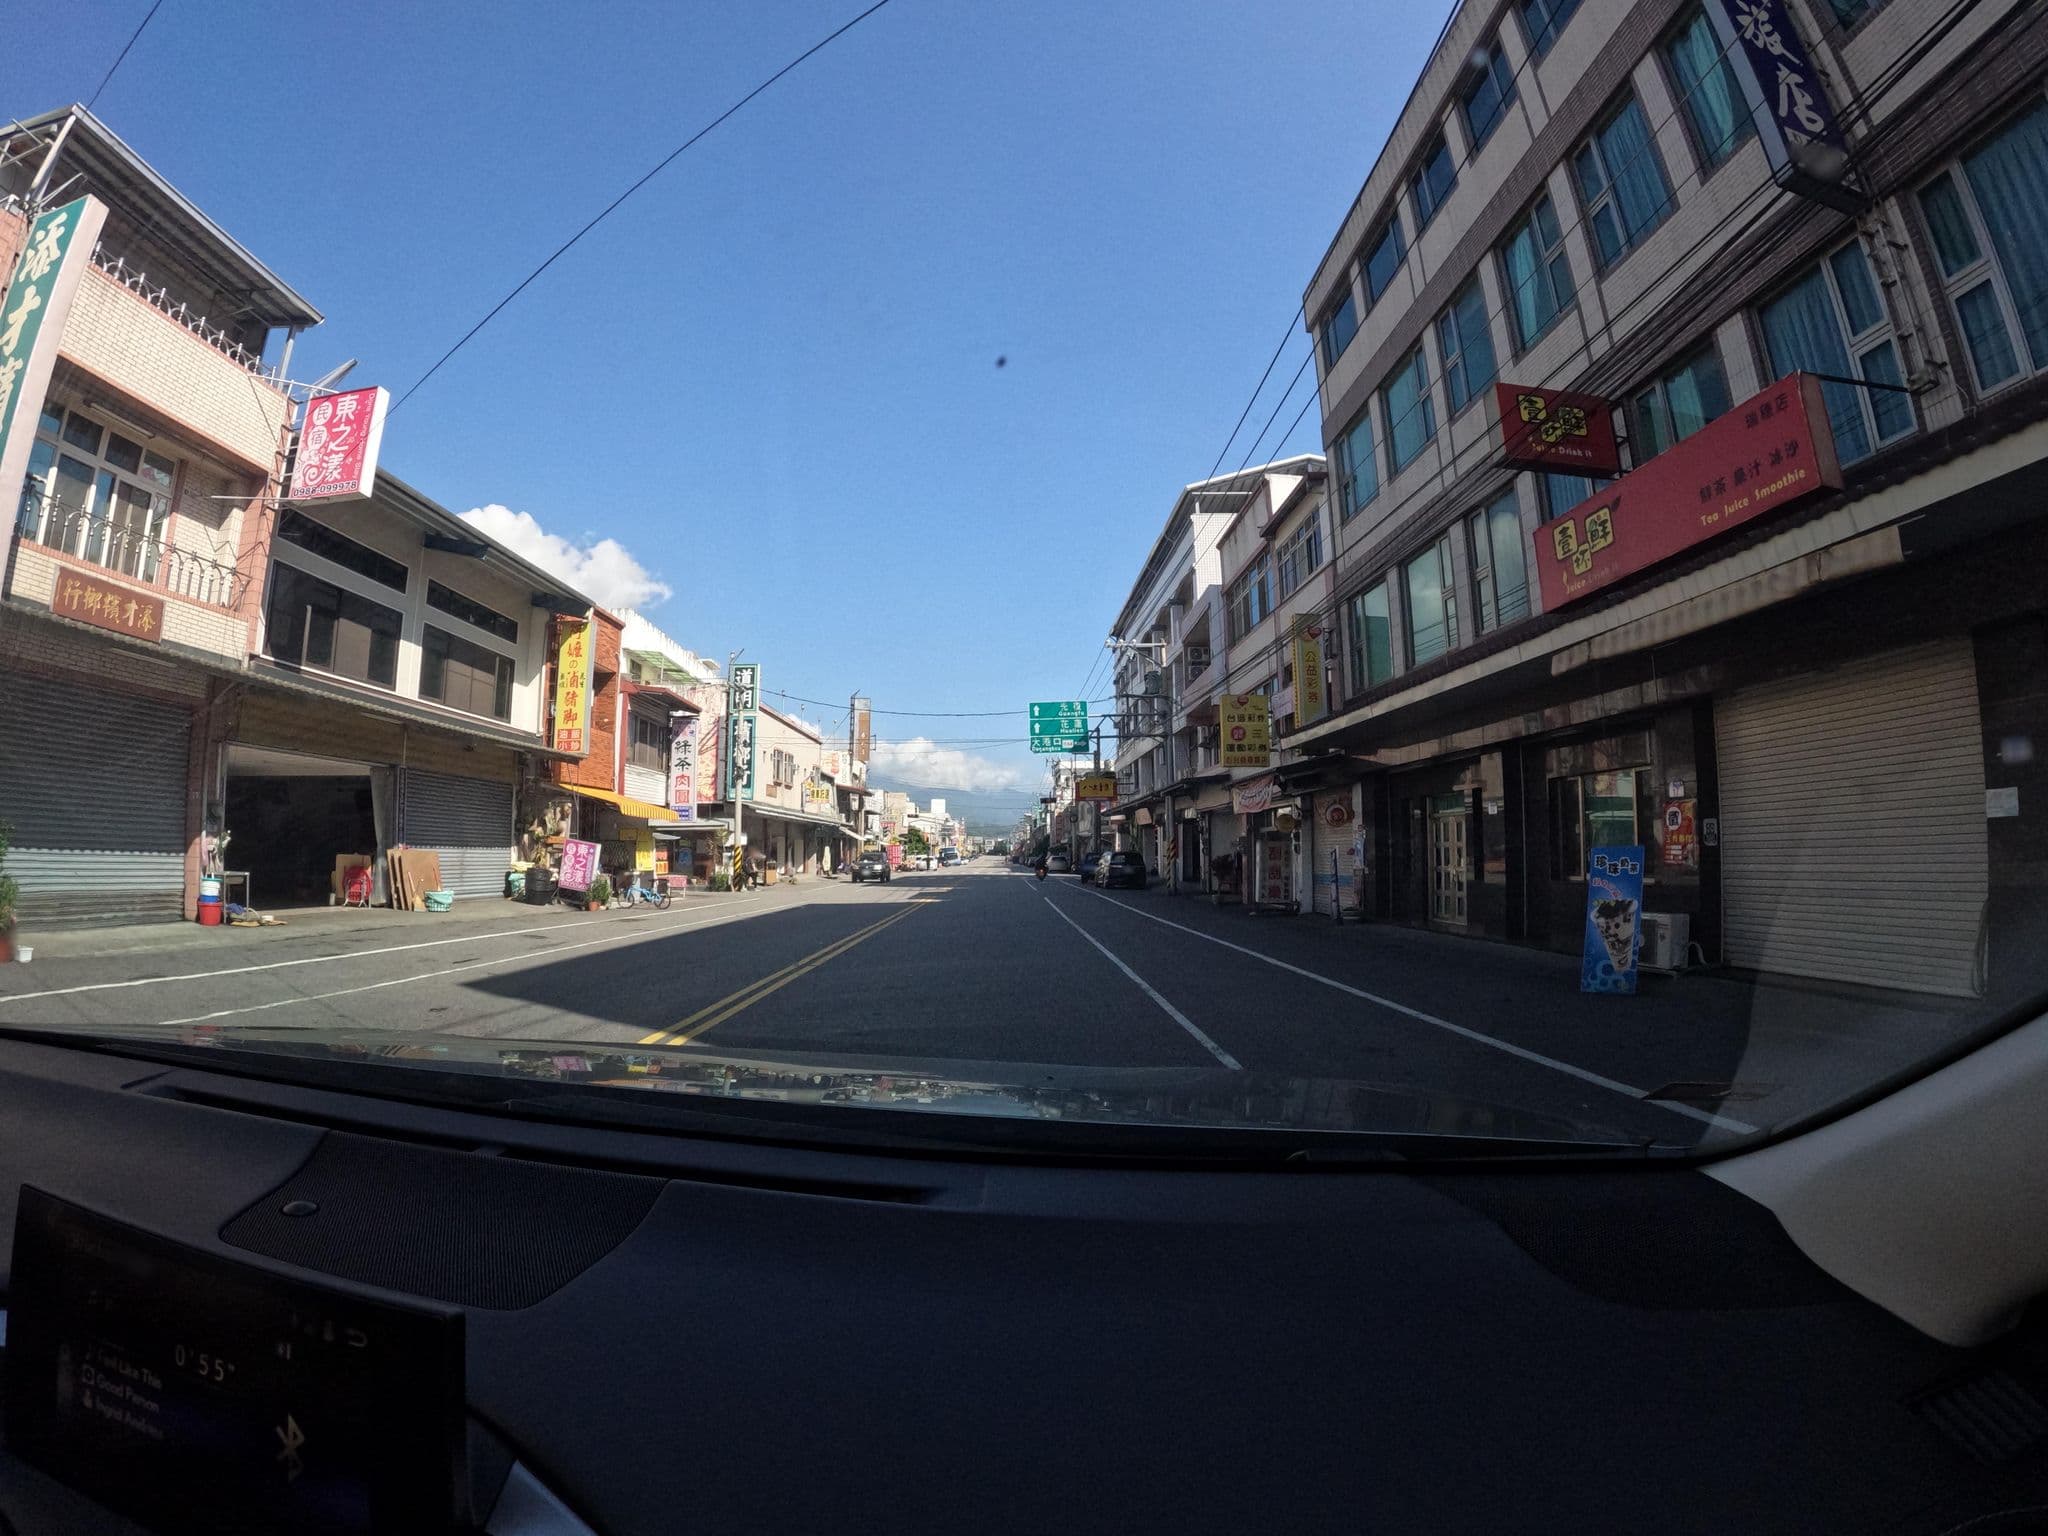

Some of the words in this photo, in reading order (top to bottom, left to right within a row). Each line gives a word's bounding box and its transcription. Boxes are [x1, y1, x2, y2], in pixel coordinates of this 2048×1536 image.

[310, 402, 331, 447] 民宿
[322, 394, 360, 481] 東之漾
[293, 482, 358, 497] 0988-099978
[1701, 513, 1719, 527] Tea
[1723, 497, 1751, 518] Juice
[1754, 467, 1807, 502] Smoothie
[1304, 650, 1319, 704] 公益彩券
[1032, 737, 1061, 746] 大港口
[1595, 855, 1639, 875] 珍珠奶茶
